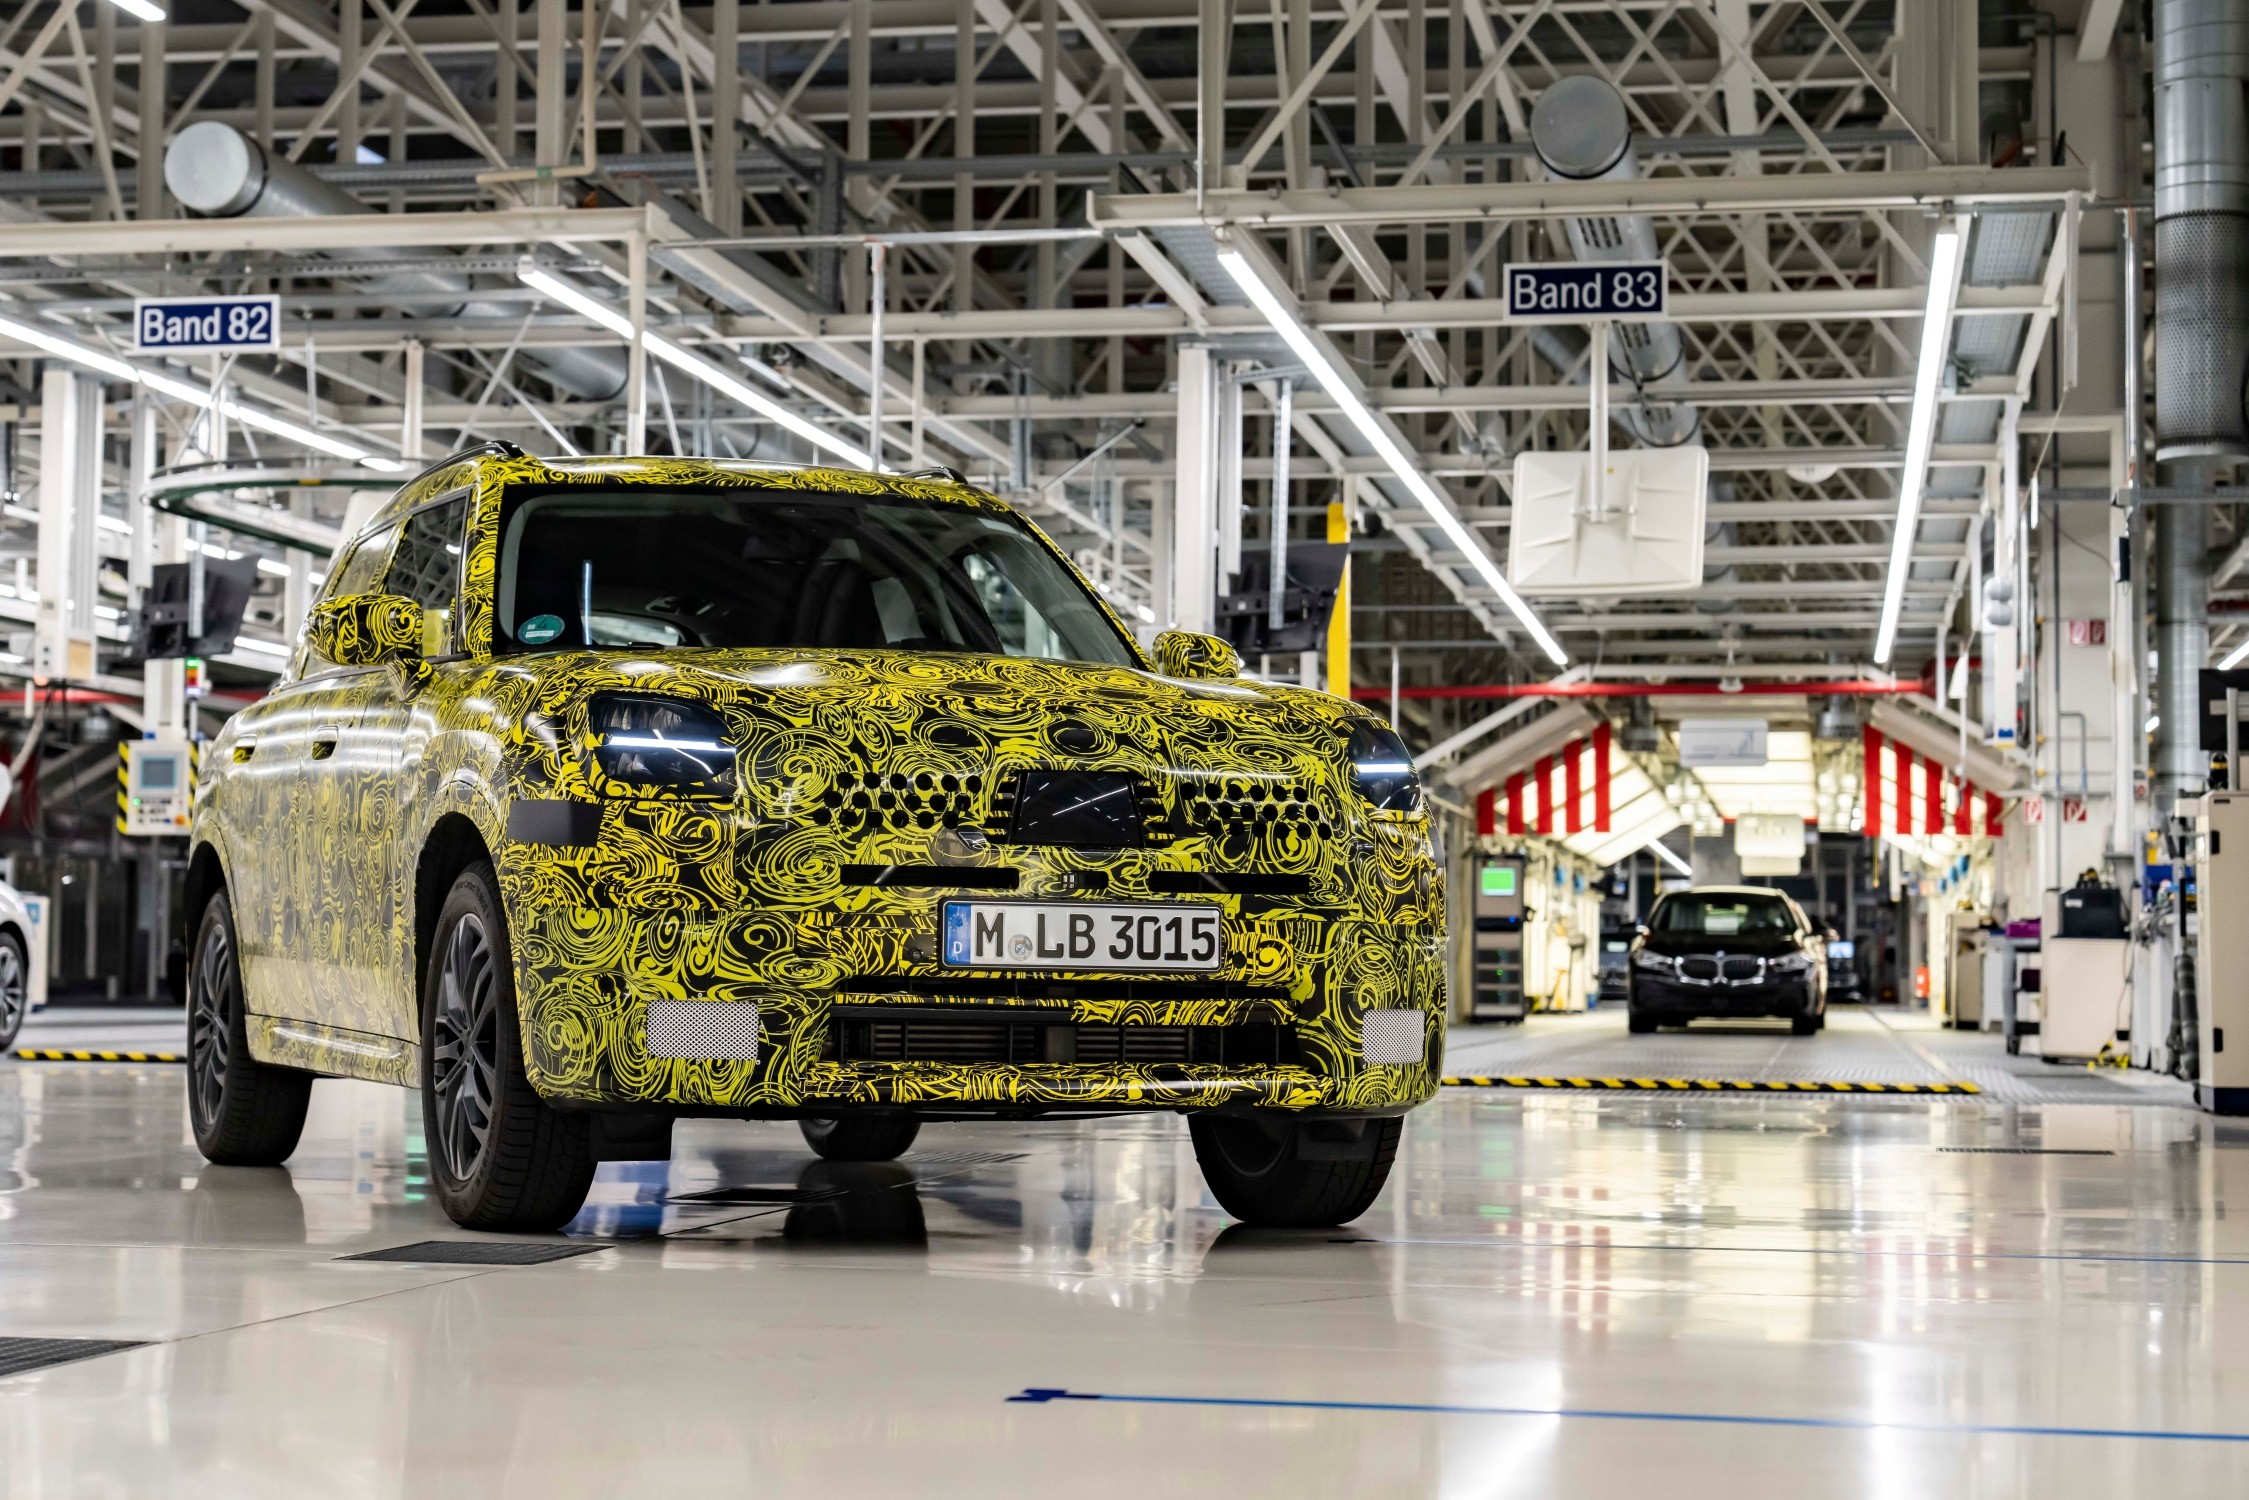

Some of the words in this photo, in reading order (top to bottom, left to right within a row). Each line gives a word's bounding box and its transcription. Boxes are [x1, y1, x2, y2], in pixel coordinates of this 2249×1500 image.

[1514, 272, 1602, 310] Band
[1611, 271, 1658, 308] 83
[143, 306, 222, 343] Band
[227, 305, 269, 342] 82
[953, 941, 963, 954] D
[975, 911, 1005, 957] M
[1036, 913, 1096, 959] LB
[1108, 914, 1216, 962] 3015
